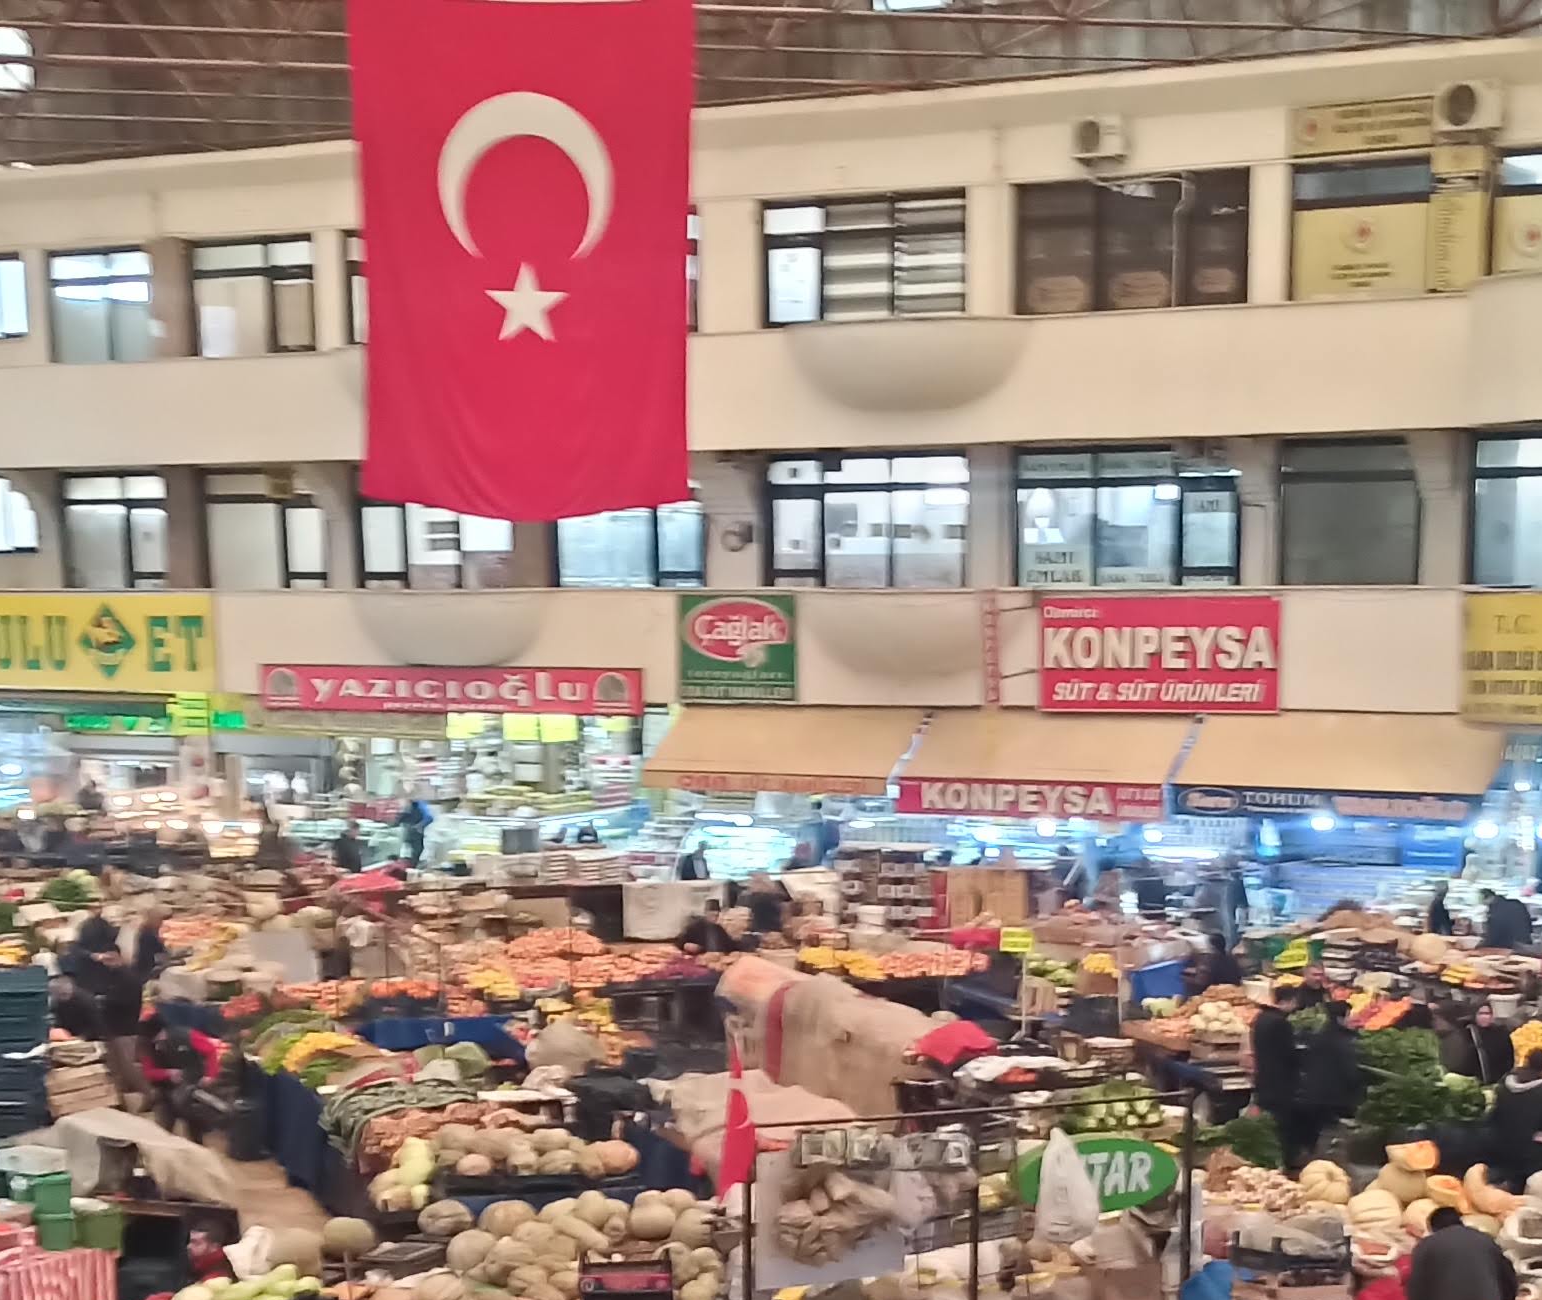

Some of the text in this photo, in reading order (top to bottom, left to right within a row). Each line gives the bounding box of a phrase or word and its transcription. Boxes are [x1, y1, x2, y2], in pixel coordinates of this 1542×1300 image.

[145, 615, 205, 672] ET
[694, 613, 781, 647] Çağlak
[1043, 626, 1277, 670] KONPEYSA
[1052, 679, 1265, 703] SÜT & SÜT ÜRÜNLERİ
[920, 781, 1110, 815] KONPEYSA
